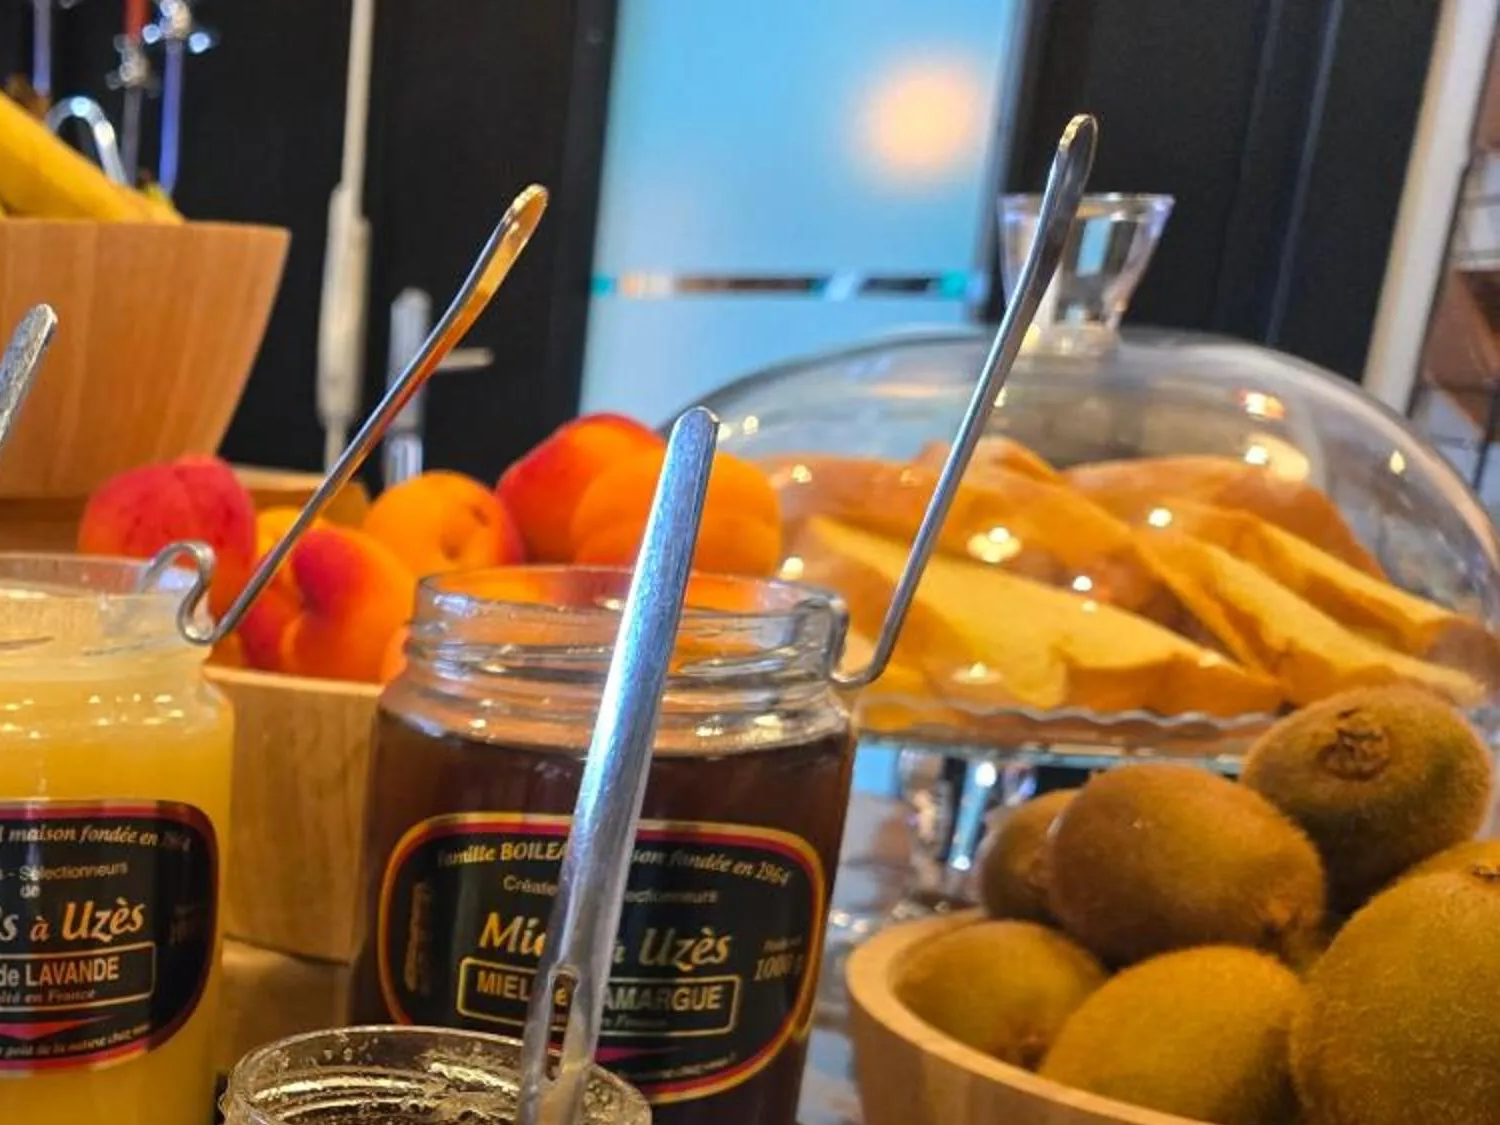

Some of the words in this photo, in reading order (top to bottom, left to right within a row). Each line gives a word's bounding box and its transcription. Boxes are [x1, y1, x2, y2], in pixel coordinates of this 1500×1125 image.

[9, 824, 76, 843] maison
[79, 824, 137, 844] fondée
[139, 831, 158, 847] en
[19, 884, 41, 899] de
[30, 915, 51, 942] à
[62, 895, 147, 943] Uzès
[638, 925, 732, 973] Uzès
[25, 955, 120, 987] LAVANDE
[476, 969, 532, 1000] MIEL
[601, 984, 722, 1011] AMARGUE
